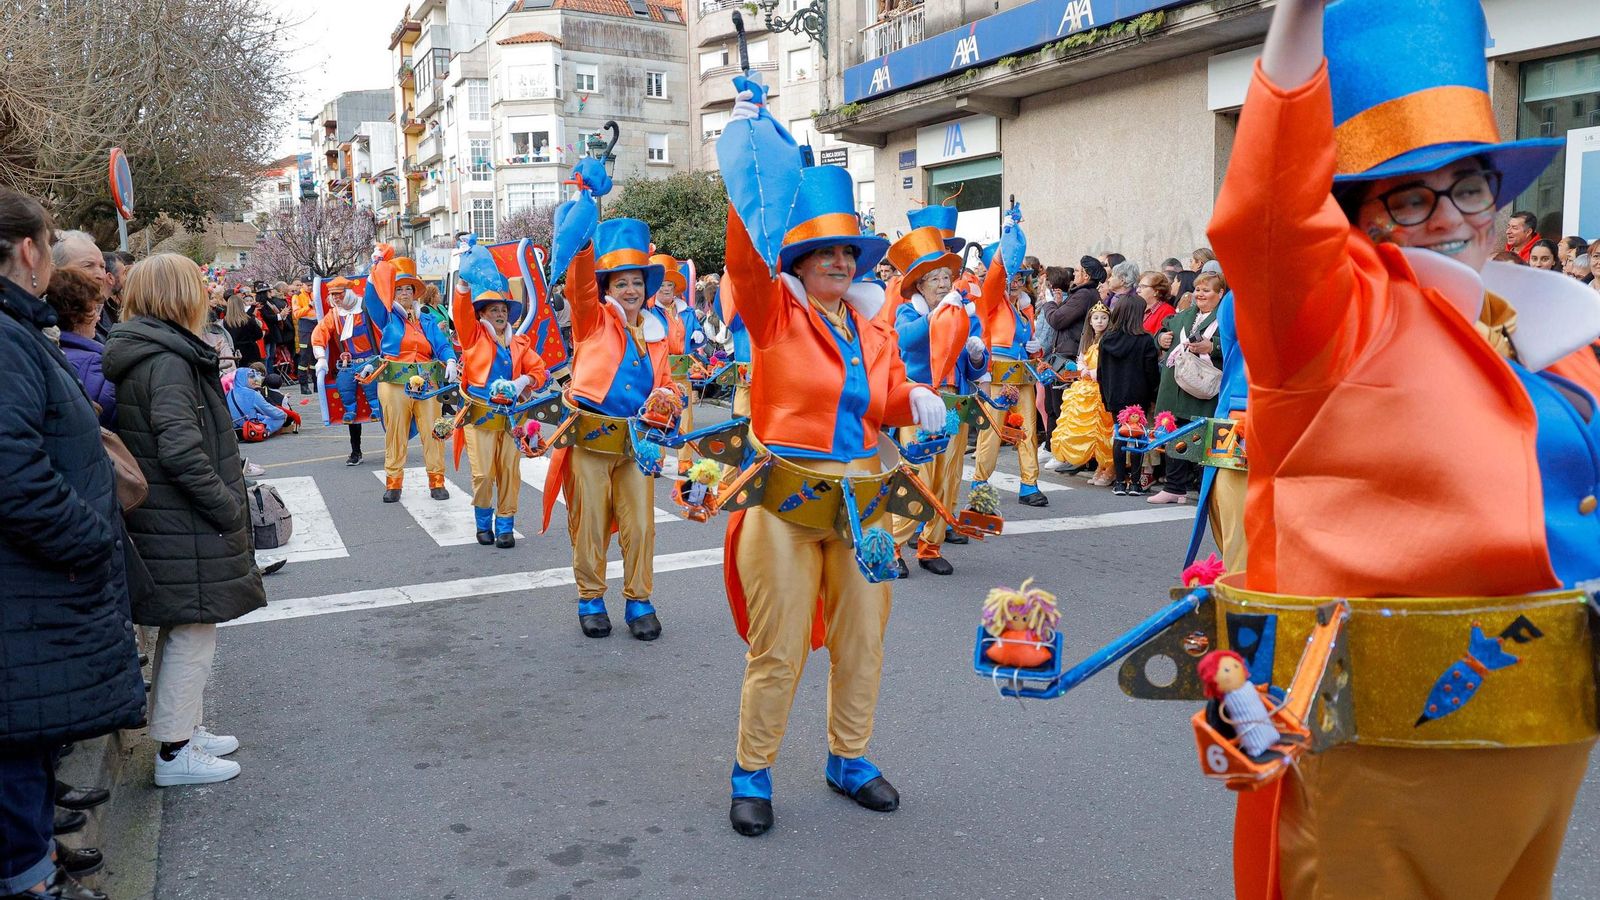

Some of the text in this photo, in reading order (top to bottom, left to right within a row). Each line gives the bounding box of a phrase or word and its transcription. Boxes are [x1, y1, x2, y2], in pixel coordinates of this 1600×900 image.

[1056, 0, 1095, 37] AXA
[950, 34, 980, 69] AXA
[868, 65, 892, 95] AXA
[1207, 744, 1229, 772] 6
